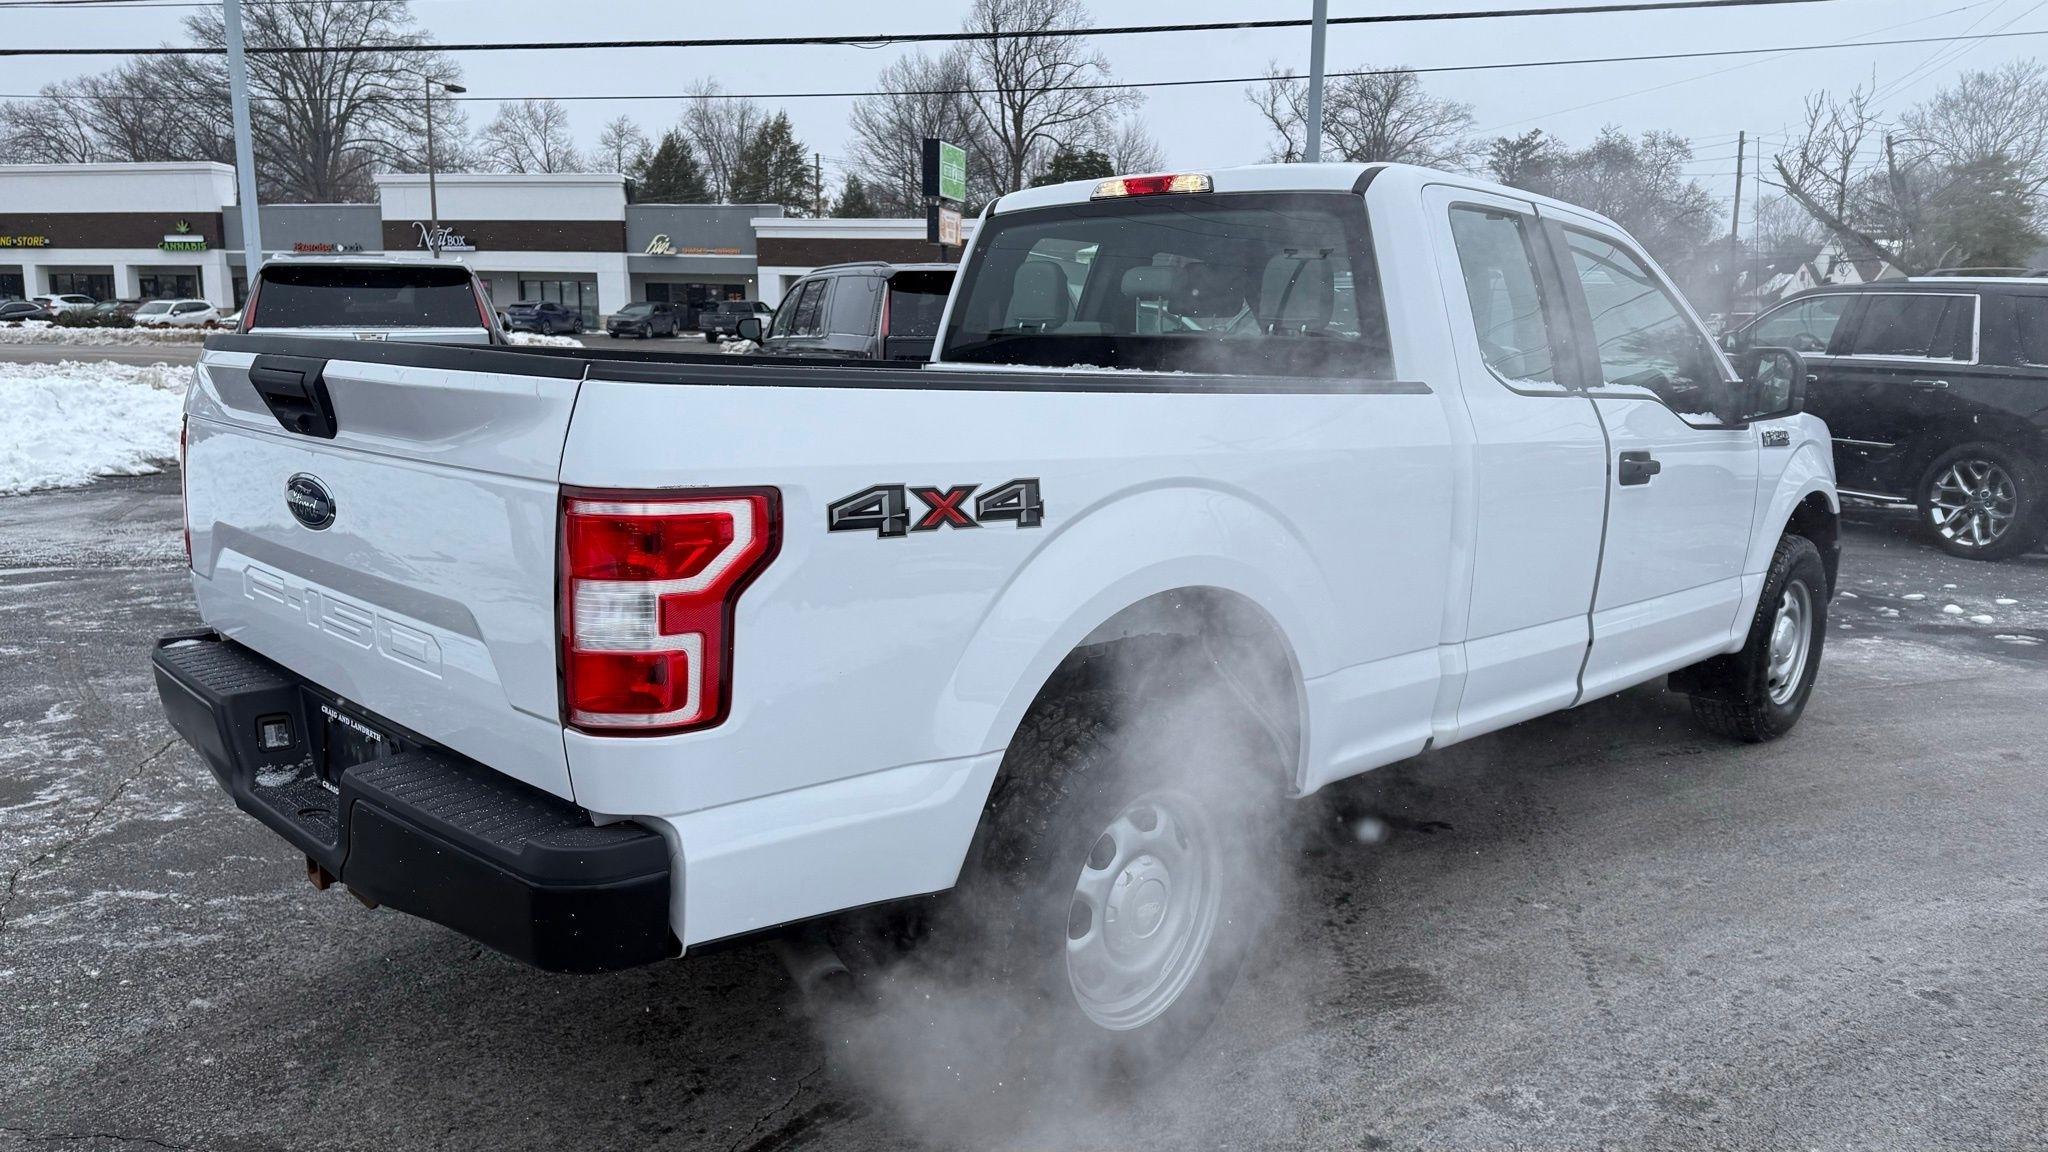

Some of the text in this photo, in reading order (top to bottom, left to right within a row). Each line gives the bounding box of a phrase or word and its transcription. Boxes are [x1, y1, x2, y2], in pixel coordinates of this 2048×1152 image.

[17, 236, 45, 246] STORE
[158, 242, 207, 251] CANNABIS
[447, 236, 465, 246] BOX
[242, 564, 443, 680] F-150
[321, 705, 381, 742] CRAIG AND LANDRETH
[322, 780, 340, 795] CRAIG
